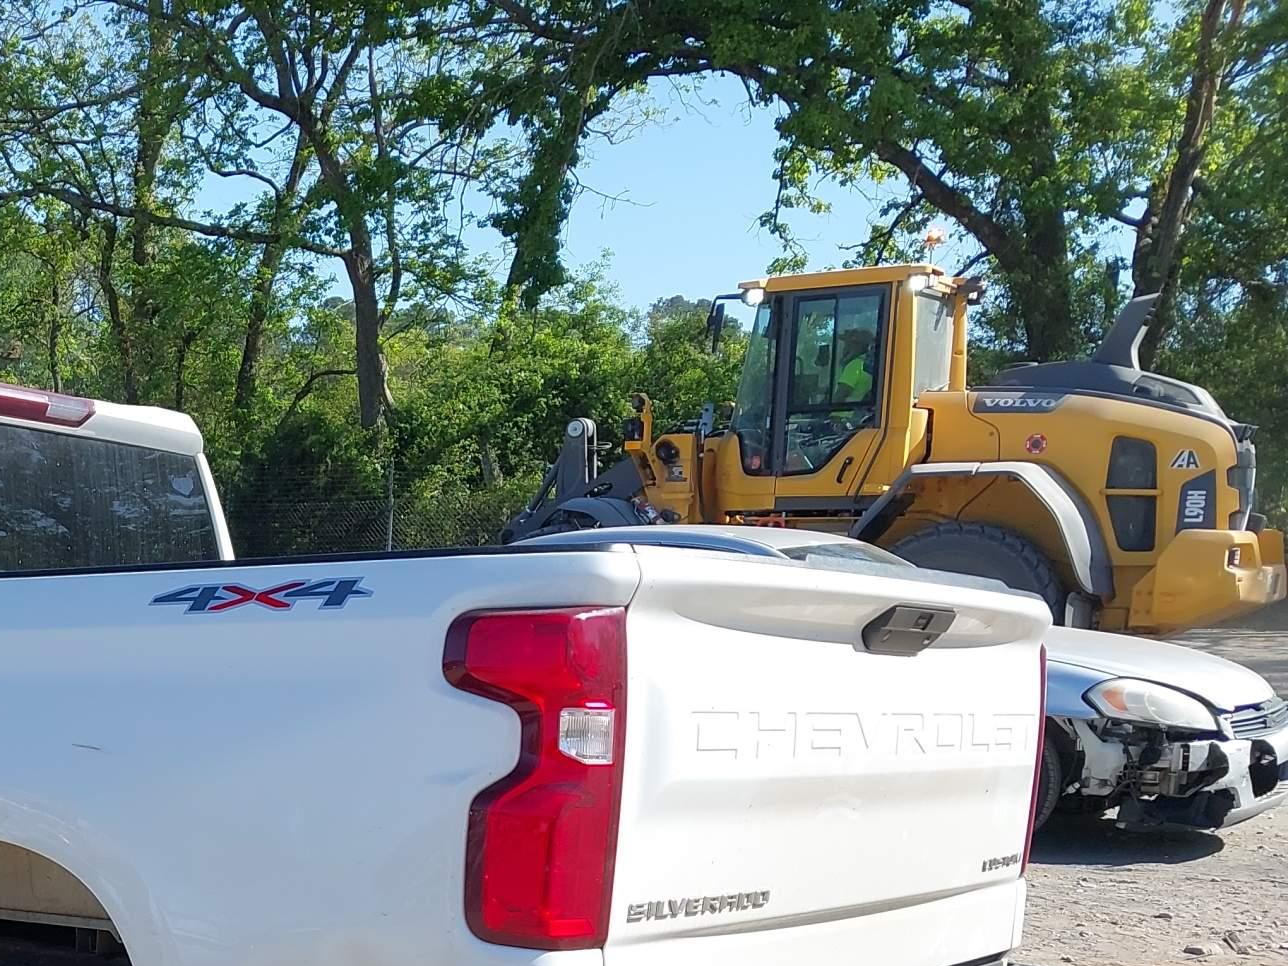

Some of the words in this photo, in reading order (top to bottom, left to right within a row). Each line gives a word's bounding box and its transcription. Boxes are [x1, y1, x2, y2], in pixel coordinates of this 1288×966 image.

[983, 398, 1056, 407] VOLVO
[1184, 490, 1207, 523] L90H
[691, 711, 1036, 759] CHEVROLET
[626, 890, 771, 924] SILVERADO
